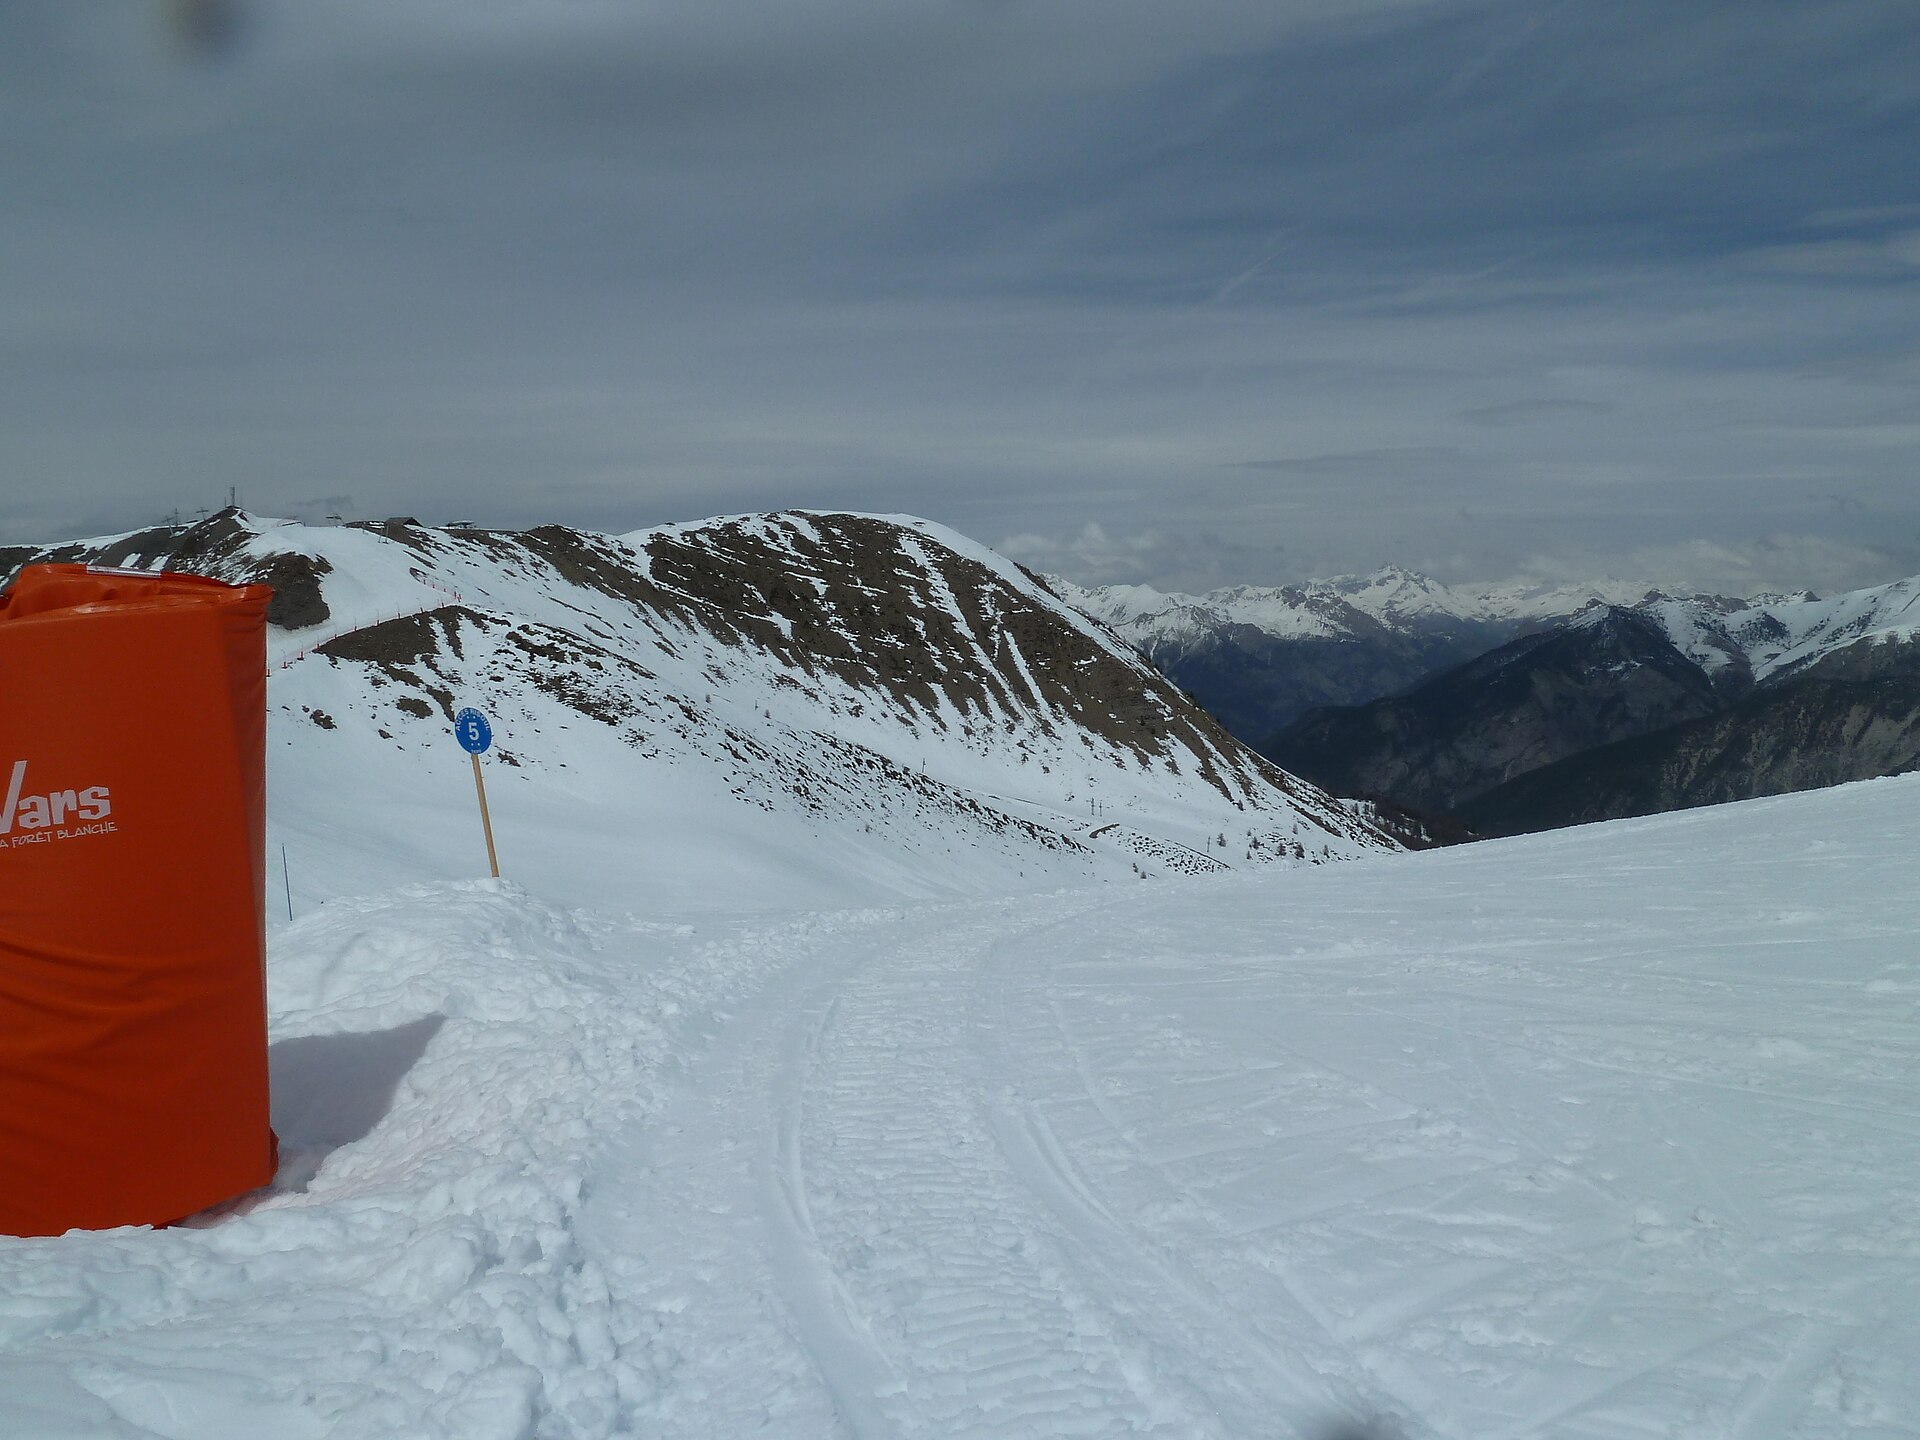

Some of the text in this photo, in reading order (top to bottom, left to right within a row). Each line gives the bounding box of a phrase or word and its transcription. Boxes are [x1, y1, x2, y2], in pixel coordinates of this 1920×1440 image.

[469, 722, 480, 741] 5
[11, 831, 53, 849] FORÊT
[57, 821, 118, 840] BLANCHE
